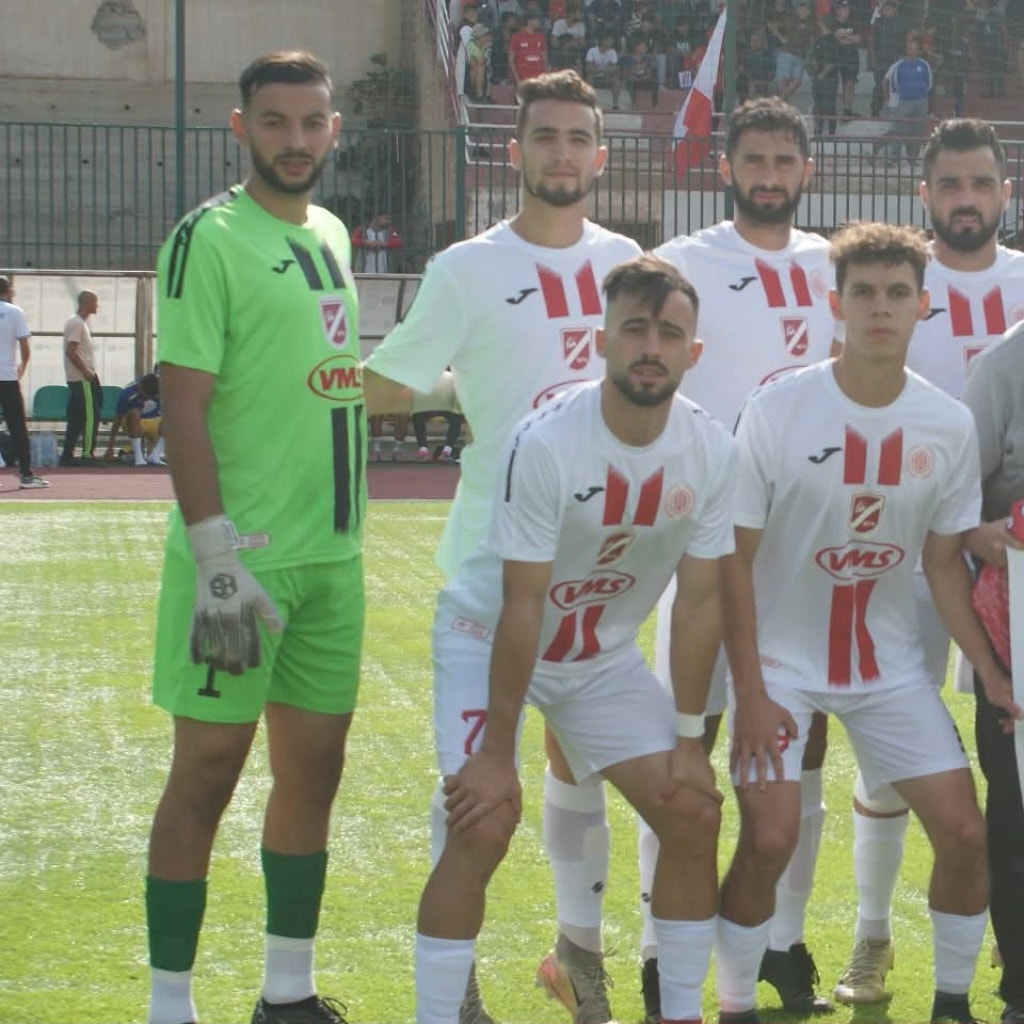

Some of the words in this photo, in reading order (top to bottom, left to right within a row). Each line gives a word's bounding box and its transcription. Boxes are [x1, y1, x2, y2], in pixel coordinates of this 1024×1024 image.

[319, 366, 362, 391] VM
[829, 549, 894, 571] VMS
[564, 577, 627, 604] VMS
[461, 709, 488, 756] 7
